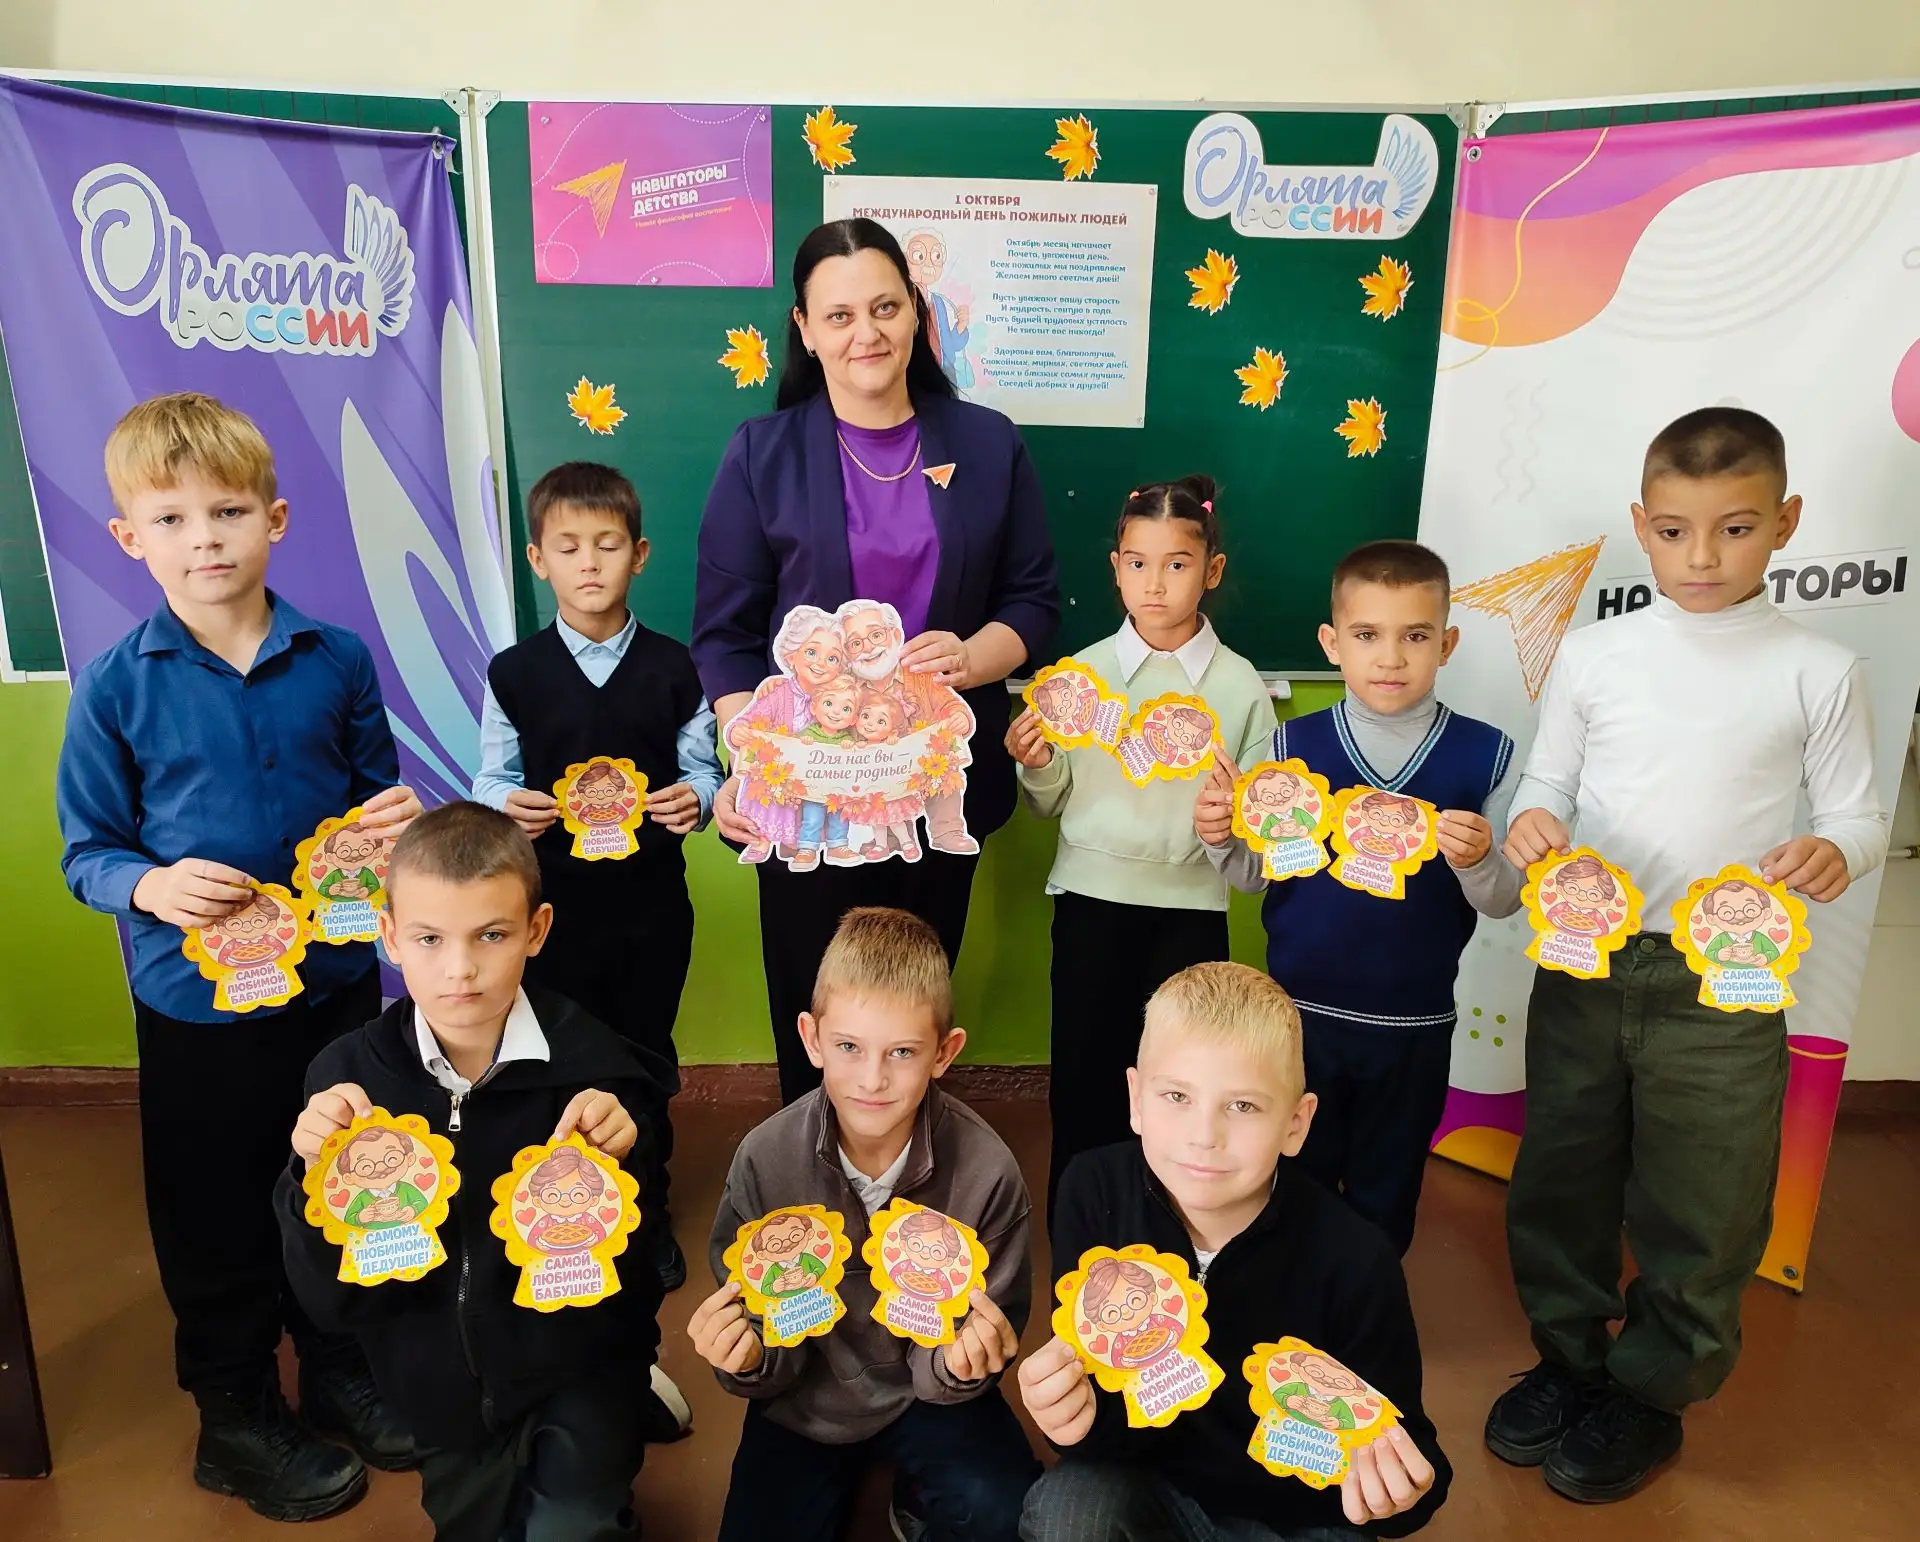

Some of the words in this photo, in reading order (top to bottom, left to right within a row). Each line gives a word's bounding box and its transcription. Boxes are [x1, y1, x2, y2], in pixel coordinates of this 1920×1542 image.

[631, 164, 727, 196] НАВИГАТОРЫ
[1195, 125, 1388, 217] Орлята
[633, 189, 699, 217] ДЕТСТВА
[964, 195, 1021, 207] ОКТЯБРЯ
[852, 207, 971, 222] МЕЖДУНАРОДНЫЙ
[974, 209, 1006, 222] ДЕНЬ
[1009, 211, 1077, 224] ПОЖИЛЫХ
[1080, 213, 1128, 226] ЛЮДЕЙ
[1241, 204, 1383, 234] РОССИИ
[82, 173, 369, 323] Орлята
[1006, 238, 1041, 249] Октябрь
[1043, 241, 1070, 250] месяц
[1071, 242, 1112, 250] начинает
[1042, 252, 1085, 261] уважения
[995, 271, 1031, 280] Желаем
[1069, 264, 1126, 273] поздравляем
[992, 293, 1016, 302] Пусть
[1084, 297, 1121, 306] старость
[1001, 304, 1007, 312] И
[177, 305, 370, 348] РОССИИ
[985, 314, 1010, 324] Пусть
[1011, 315, 1042, 325] будней
[1044, 317, 1084, 326] трудовых
[1086, 318, 1128, 327] усталость
[1007, 326, 1018, 334] Не
[1019, 327, 1050, 335] тяготит
[998, 379, 1033, 389] Соседей
[1034, 380, 1067, 389] добрых
[1094, 703, 1108, 731] САМОЙ
[1100, 701, 1117, 742] ЛЮБИМОЙ
[1108, 704, 1124, 743] БАБУШКЕ!
[807, 749, 842, 765] Для
[845, 752, 872, 765] нас
[874, 748, 893, 763] вы
[1122, 735, 1150, 774] ЛЮБИМОЙ
[1134, 738, 1155, 764] САМОЙ
[805, 765, 851, 780] самые
[854, 760, 913, 783] родные!
[582, 834, 627, 847] ЛЮБИМОЙ
[589, 825, 619, 836] САМОЙ
[584, 843, 628, 854] БАБУШКЕ!
[1271, 847, 1320, 866] ЛЮБИМОМУ
[1276, 839, 1312, 853] САМОМУ
[1275, 857, 1319, 875] ДЕДУШКЕ!
[1342, 863, 1393, 884] ЛЮБИМОЙ
[1355, 856, 1389, 873] САМОЙ
[1342, 872, 1391, 893] БАБУШКЕ!
[331, 901, 371, 913] САМОМУ
[323, 912, 379, 926] ЛЮБИМОМУ
[327, 922, 378, 937] ДЕДУШКЕ!
[1542, 941, 1597, 963] ЛЮБИМОЙ
[1554, 933, 1592, 950] САМОЙ
[235, 963, 276, 981] САМОЙ
[1541, 953, 1595, 973] БАБУШКЕ!
[227, 973, 286, 996] ЛЮБИМОЙ
[1722, 969, 1771, 981] САМОМУ
[230, 984, 288, 1005] БАБУШКЕ!
[1712, 980, 1782, 993] ЛЮБИМОМУ
[1717, 992, 1781, 1005] ДЕДУШКЕ!
[365, 1223, 420, 1245] САМОМУ
[355, 1236, 431, 1262] ЛЮБИМОМУ
[360, 1252, 429, 1277] ДЕДУШКЕ!
[544, 1251, 591, 1270] САМОЙ
[532, 1264, 601, 1287] ЛЮБИМОЙ
[534, 1281, 602, 1301] БАБУШКЕ!
[780, 1287, 823, 1311] САМОМУ
[773, 1295, 833, 1329] ЛЮБИМОМУ
[888, 1302, 942, 1329] ЛЮБИМОЙ
[898, 1295, 937, 1316] САМОЙ
[780, 1307, 834, 1339] ДЕДУШКЕ!
[887, 1314, 941, 1339] БАБУШКЕ!
[1140, 1350, 1185, 1384] САМОЙ
[1136, 1358, 1201, 1406] ЛЮБИМОЙ
[1144, 1376, 1209, 1418] БАБУШКЕ!
[1282, 1418, 1338, 1446] САМОМУ
[1265, 1430, 1343, 1462] ЛЮБИМОМУ
[1266, 1446, 1335, 1476] ДЕДУШКЕ!
